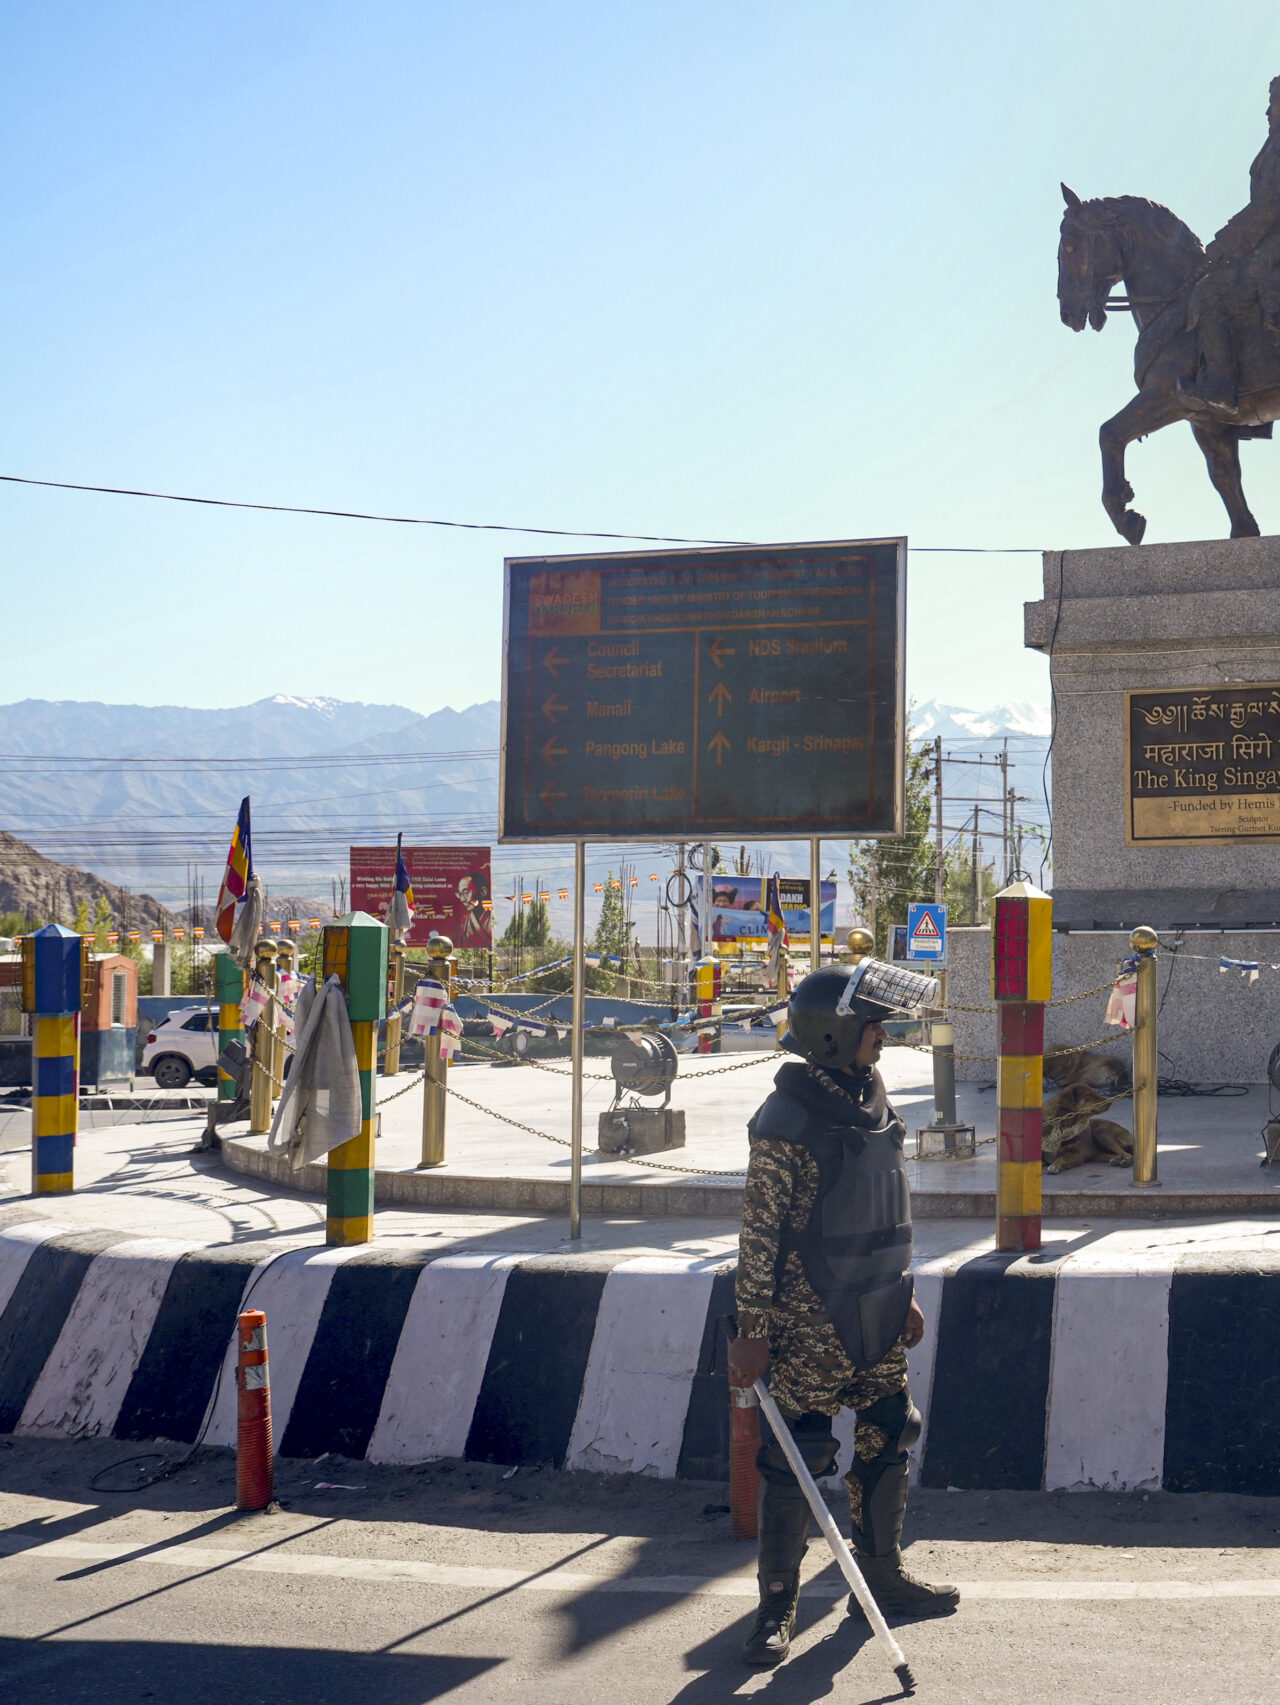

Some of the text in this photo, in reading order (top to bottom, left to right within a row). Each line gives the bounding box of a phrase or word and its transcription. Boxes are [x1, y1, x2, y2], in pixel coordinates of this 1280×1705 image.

[765, 569, 806, 581] TOURIST
[534, 591, 598, 604] SWADESH
[607, 594, 646, 607] FUNDED
[671, 592, 687, 605] BY
[687, 591, 731, 604] MINISTRY
[732, 590, 746, 601] OF
[534, 603, 598, 616] DARSHAN
[606, 615, 619, 625] OF
[648, 612, 680, 624] UNDER
[587, 639, 640, 657] Council
[749, 637, 848, 656] NDS Stadium
[587, 660, 664, 679] Secretariat
[748, 687, 802, 708] Airport
[586, 698, 633, 717] Manali
[585, 738, 686, 760] Pangong Lake
[747, 736, 791, 757] Kargil
[803, 734, 866, 755] Srinagar
[1143, 742, 1225, 766] महाराजा
[1231, 732, 1272, 760] सिंगे
[1133, 769, 1169, 789] The
[1174, 768, 1218, 792] King
[653, 785, 687, 801] Lake
[1168, 800, 1216, 812] -Funded
[1219, 799, 1234, 812] by
[1238, 798, 1276, 810] Hemis
[1238, 815, 1269, 825] Sculptor
[1209, 825, 1237, 834] Tsering
